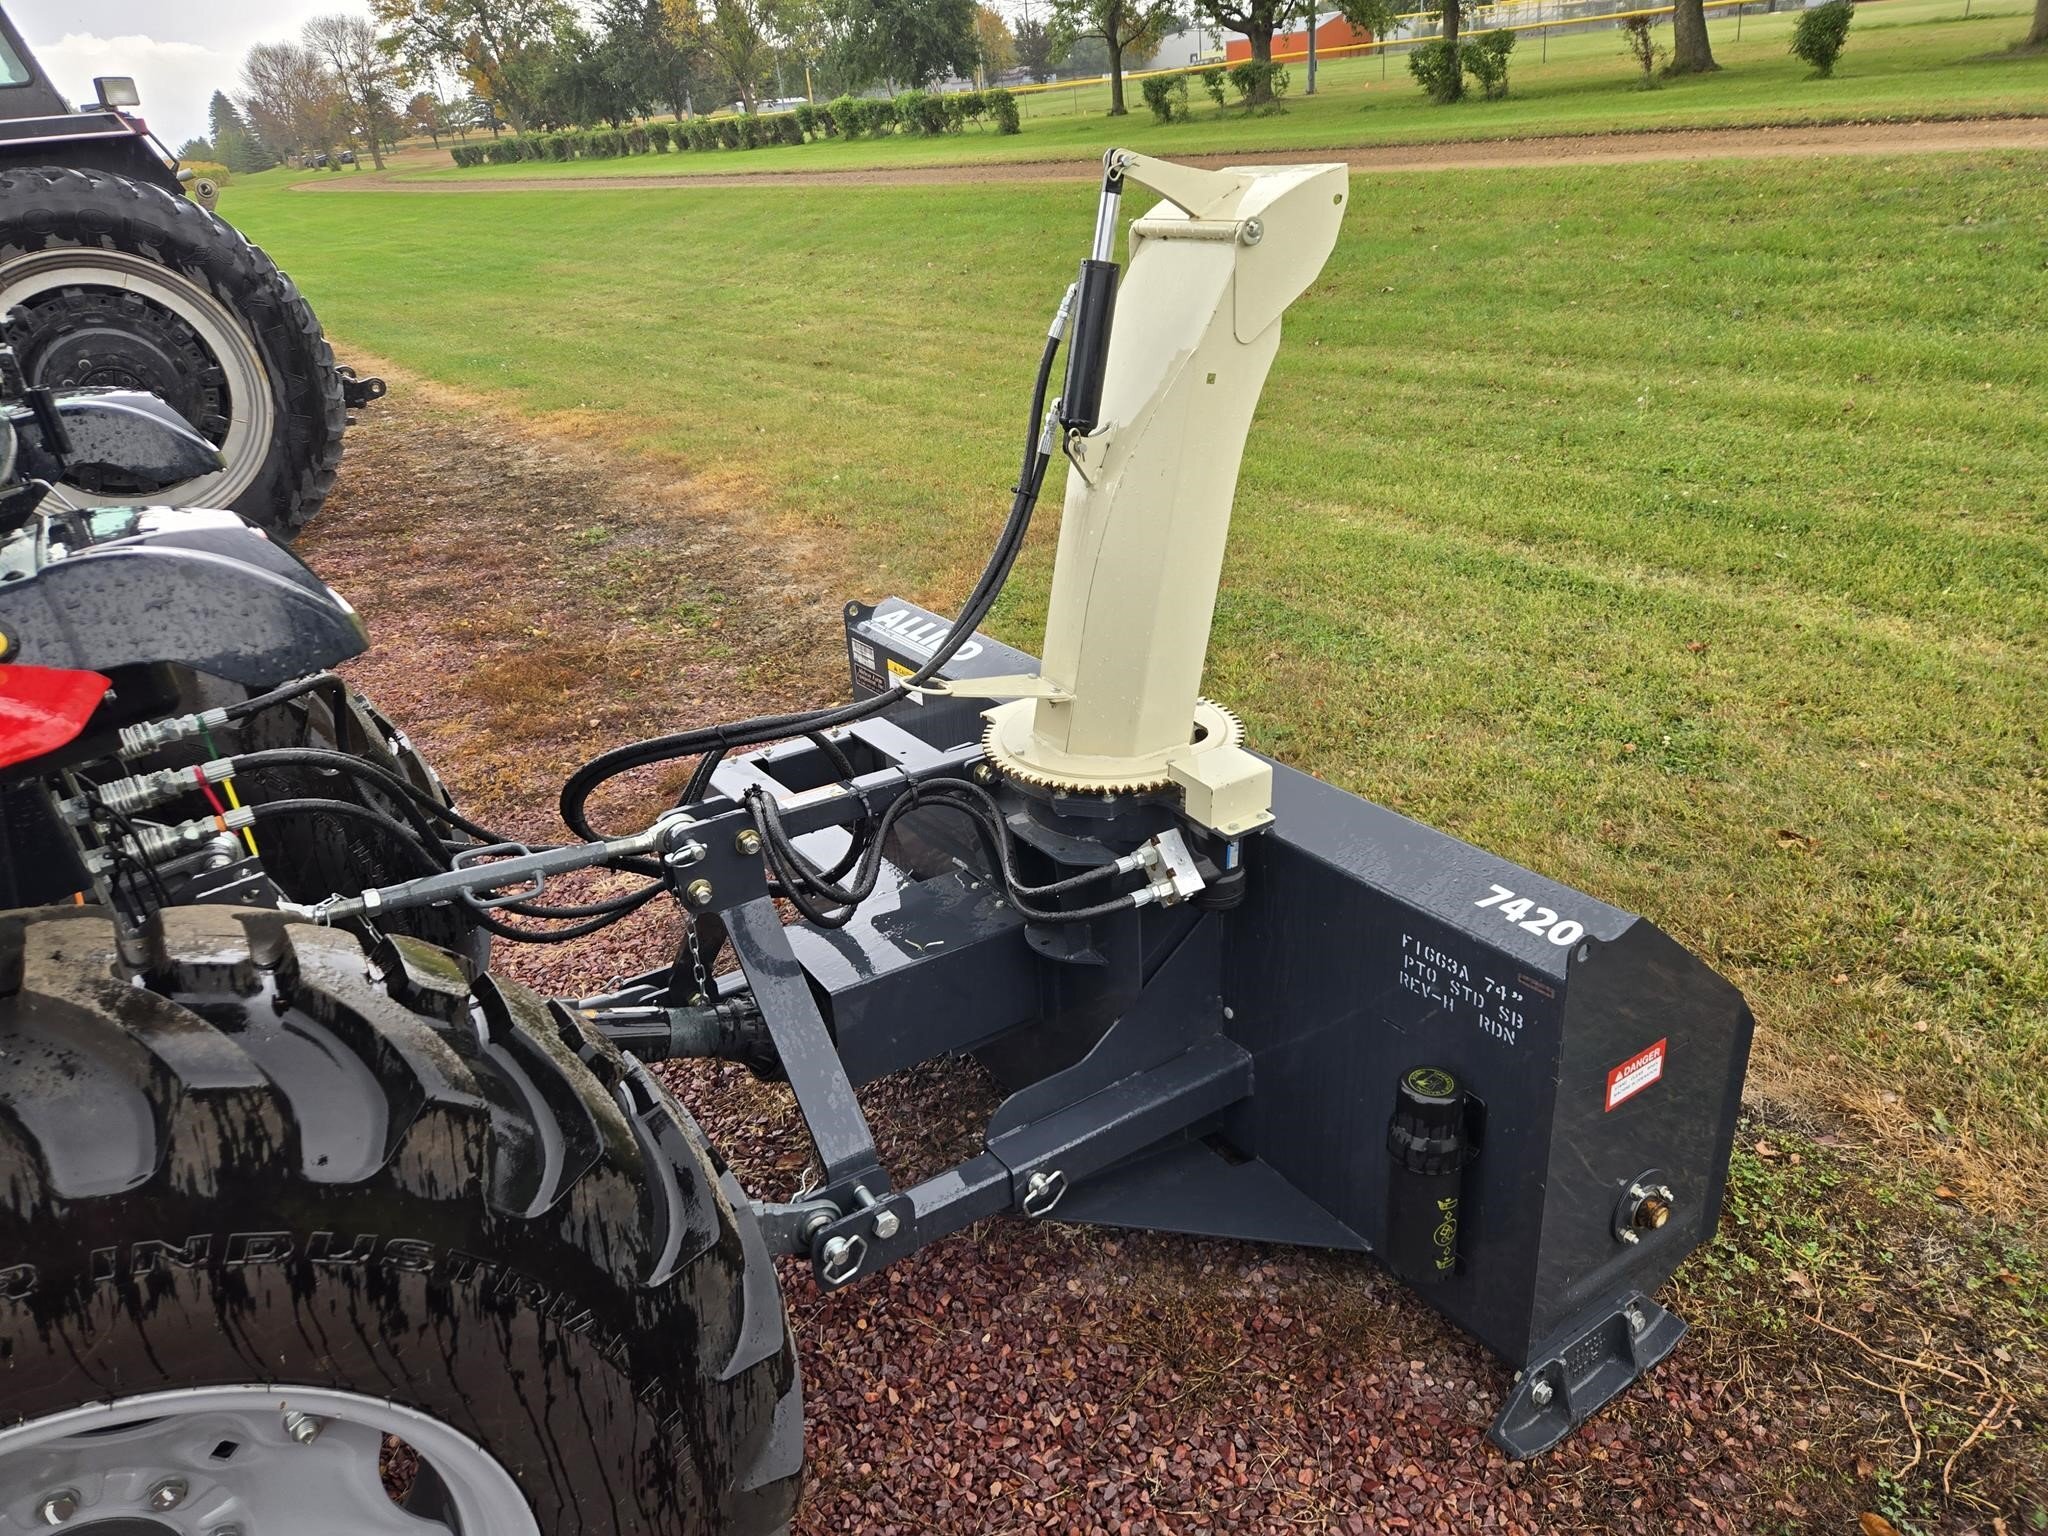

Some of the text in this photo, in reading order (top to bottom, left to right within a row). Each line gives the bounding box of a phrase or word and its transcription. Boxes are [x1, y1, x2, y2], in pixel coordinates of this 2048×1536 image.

[872, 610, 983, 661] ALLID
[1474, 883, 1584, 946] 7420
[1399, 970, 1455, 1013] REV-H
[1404, 954, 1437, 983] PTO
[1449, 980, 1485, 1009] STD
[1498, 1005, 1524, 1029] SB
[1479, 1013, 1515, 1046] RDN
[1623, 1047, 1661, 1077] DANGER
